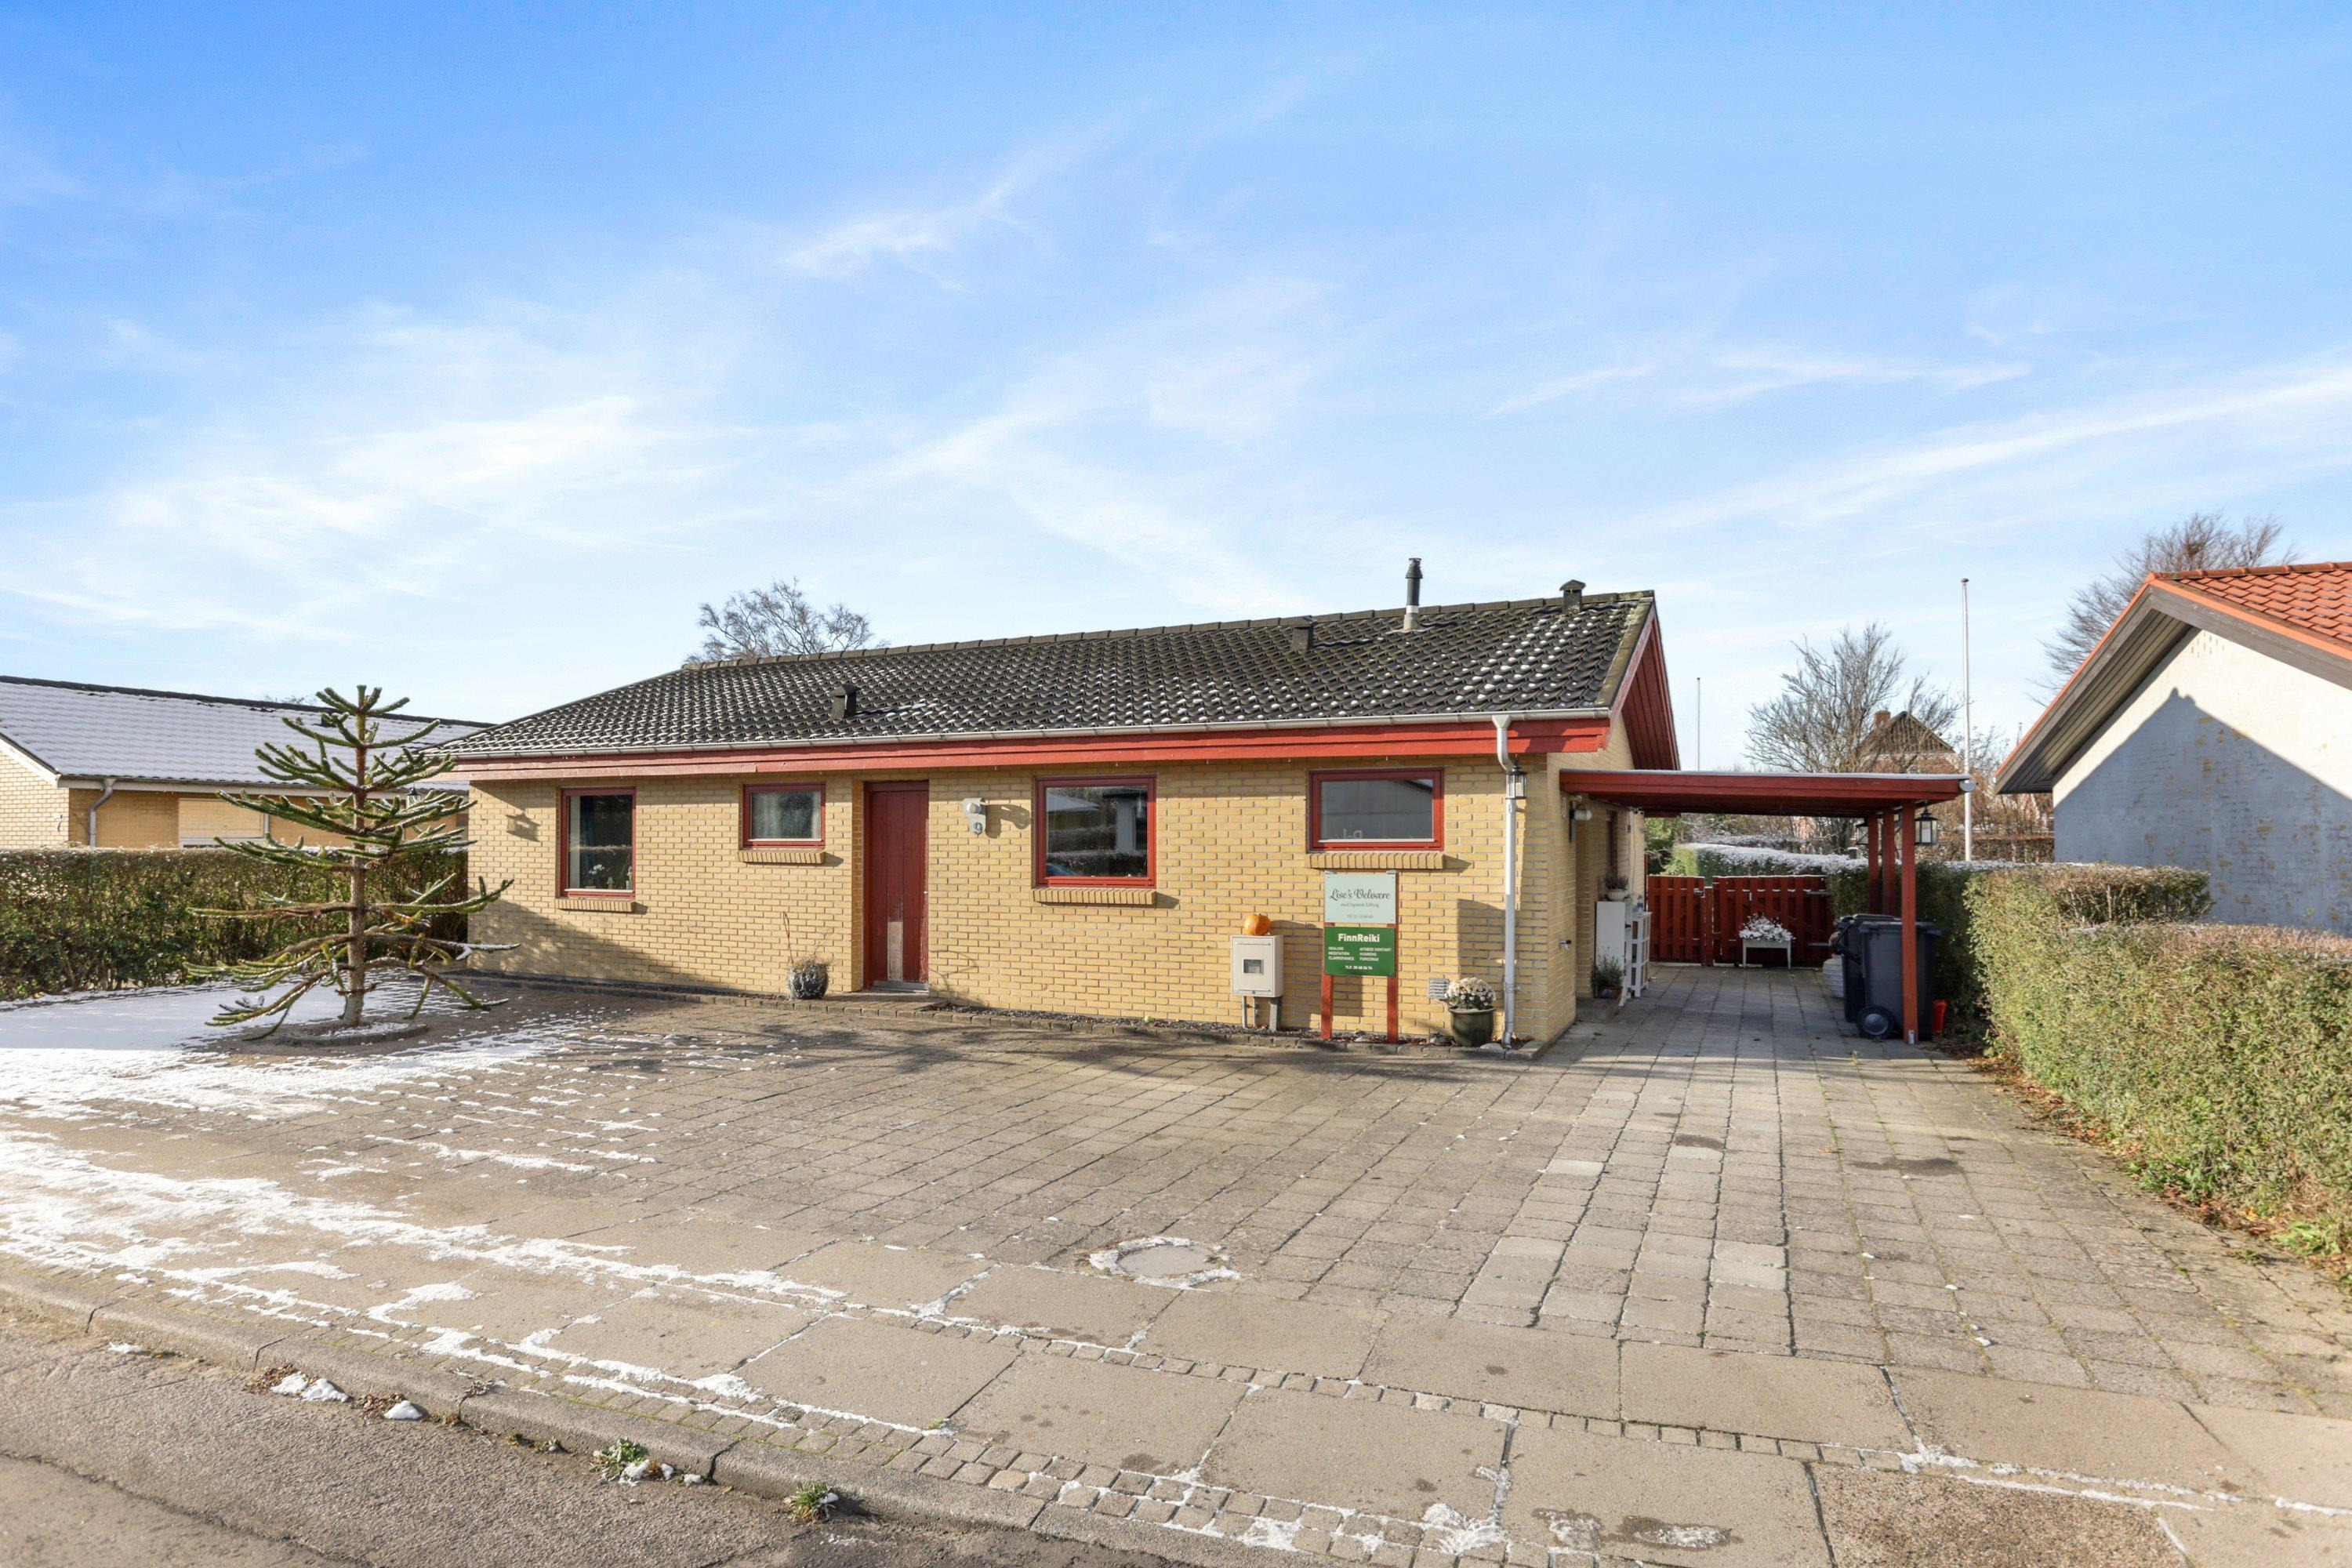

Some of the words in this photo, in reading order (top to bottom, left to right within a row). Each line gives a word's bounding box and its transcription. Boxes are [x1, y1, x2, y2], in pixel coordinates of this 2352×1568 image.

[1330, 888, 1353, 901] Lise's
[1354, 888, 1390, 899] Velvære
[1338, 933, 1381, 942] FinnReiki
